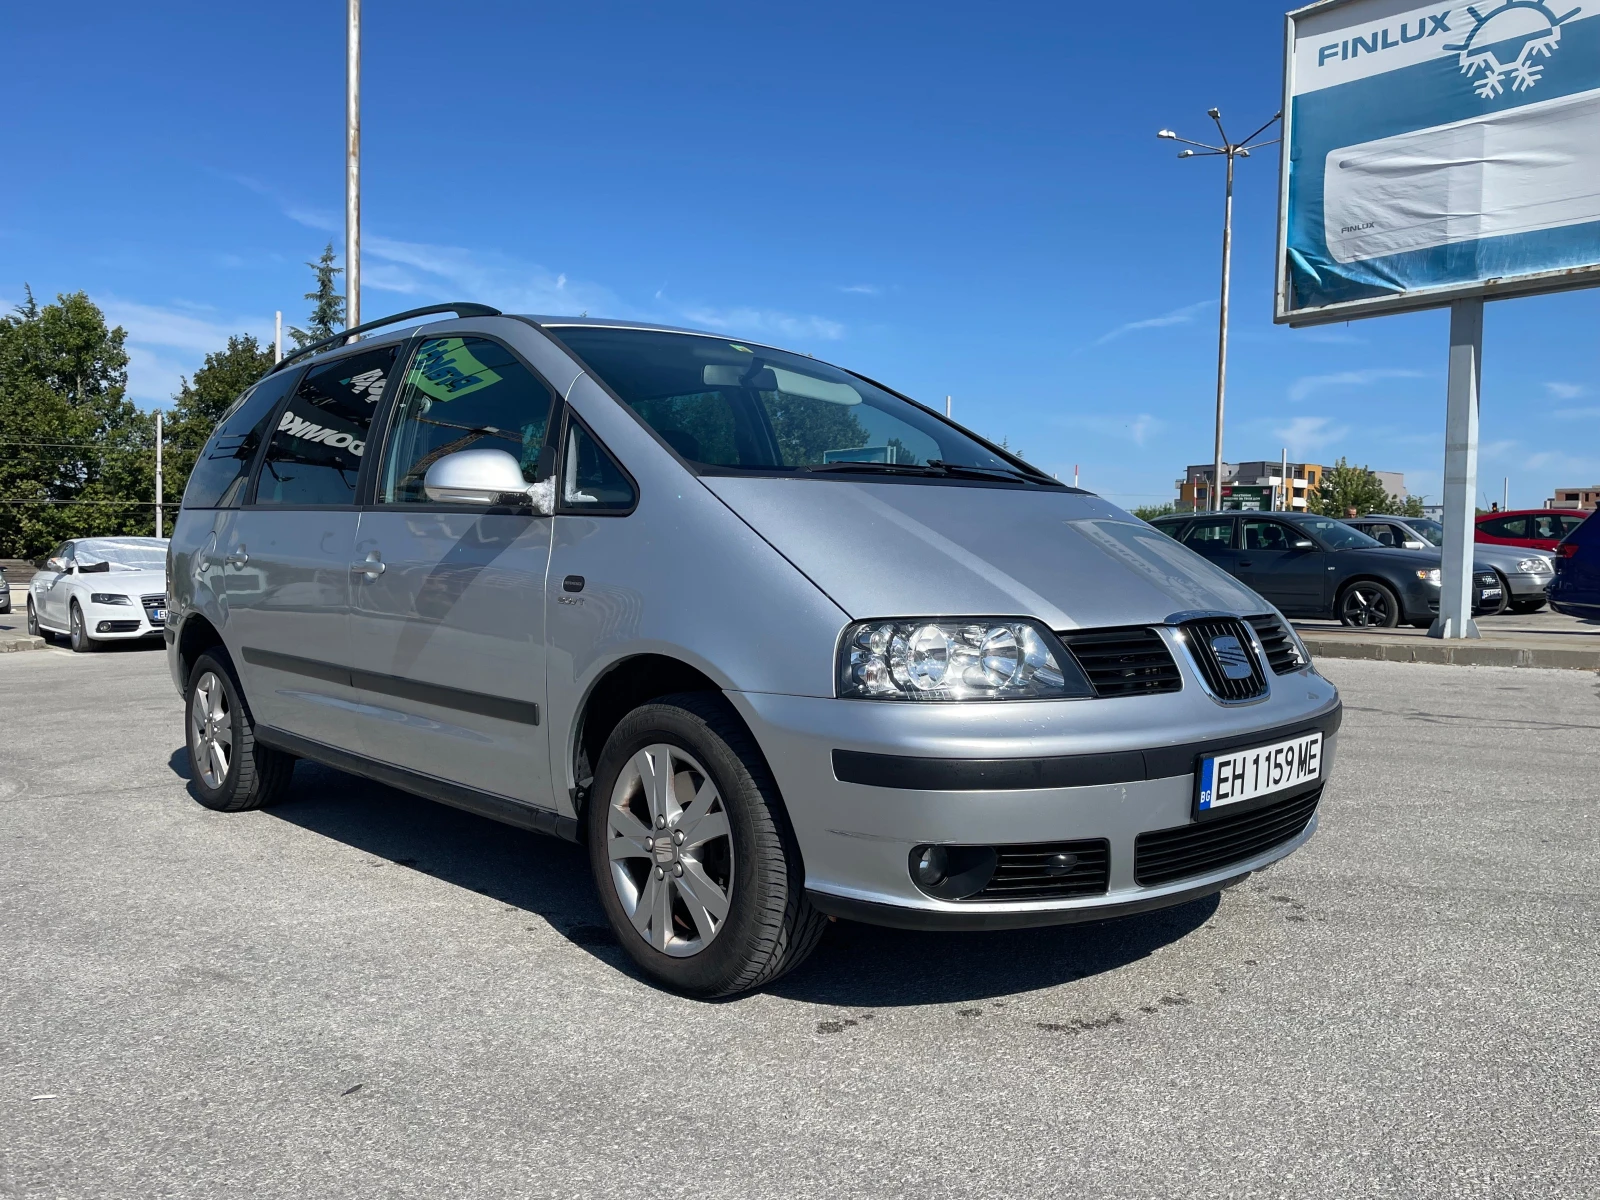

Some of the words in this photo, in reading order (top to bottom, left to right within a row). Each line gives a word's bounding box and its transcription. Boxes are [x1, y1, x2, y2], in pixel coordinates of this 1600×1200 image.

[1318, 10, 1452, 67] FINLUX
[1341, 222, 1375, 234] FINLUX
[1200, 790, 1211, 803] BG
